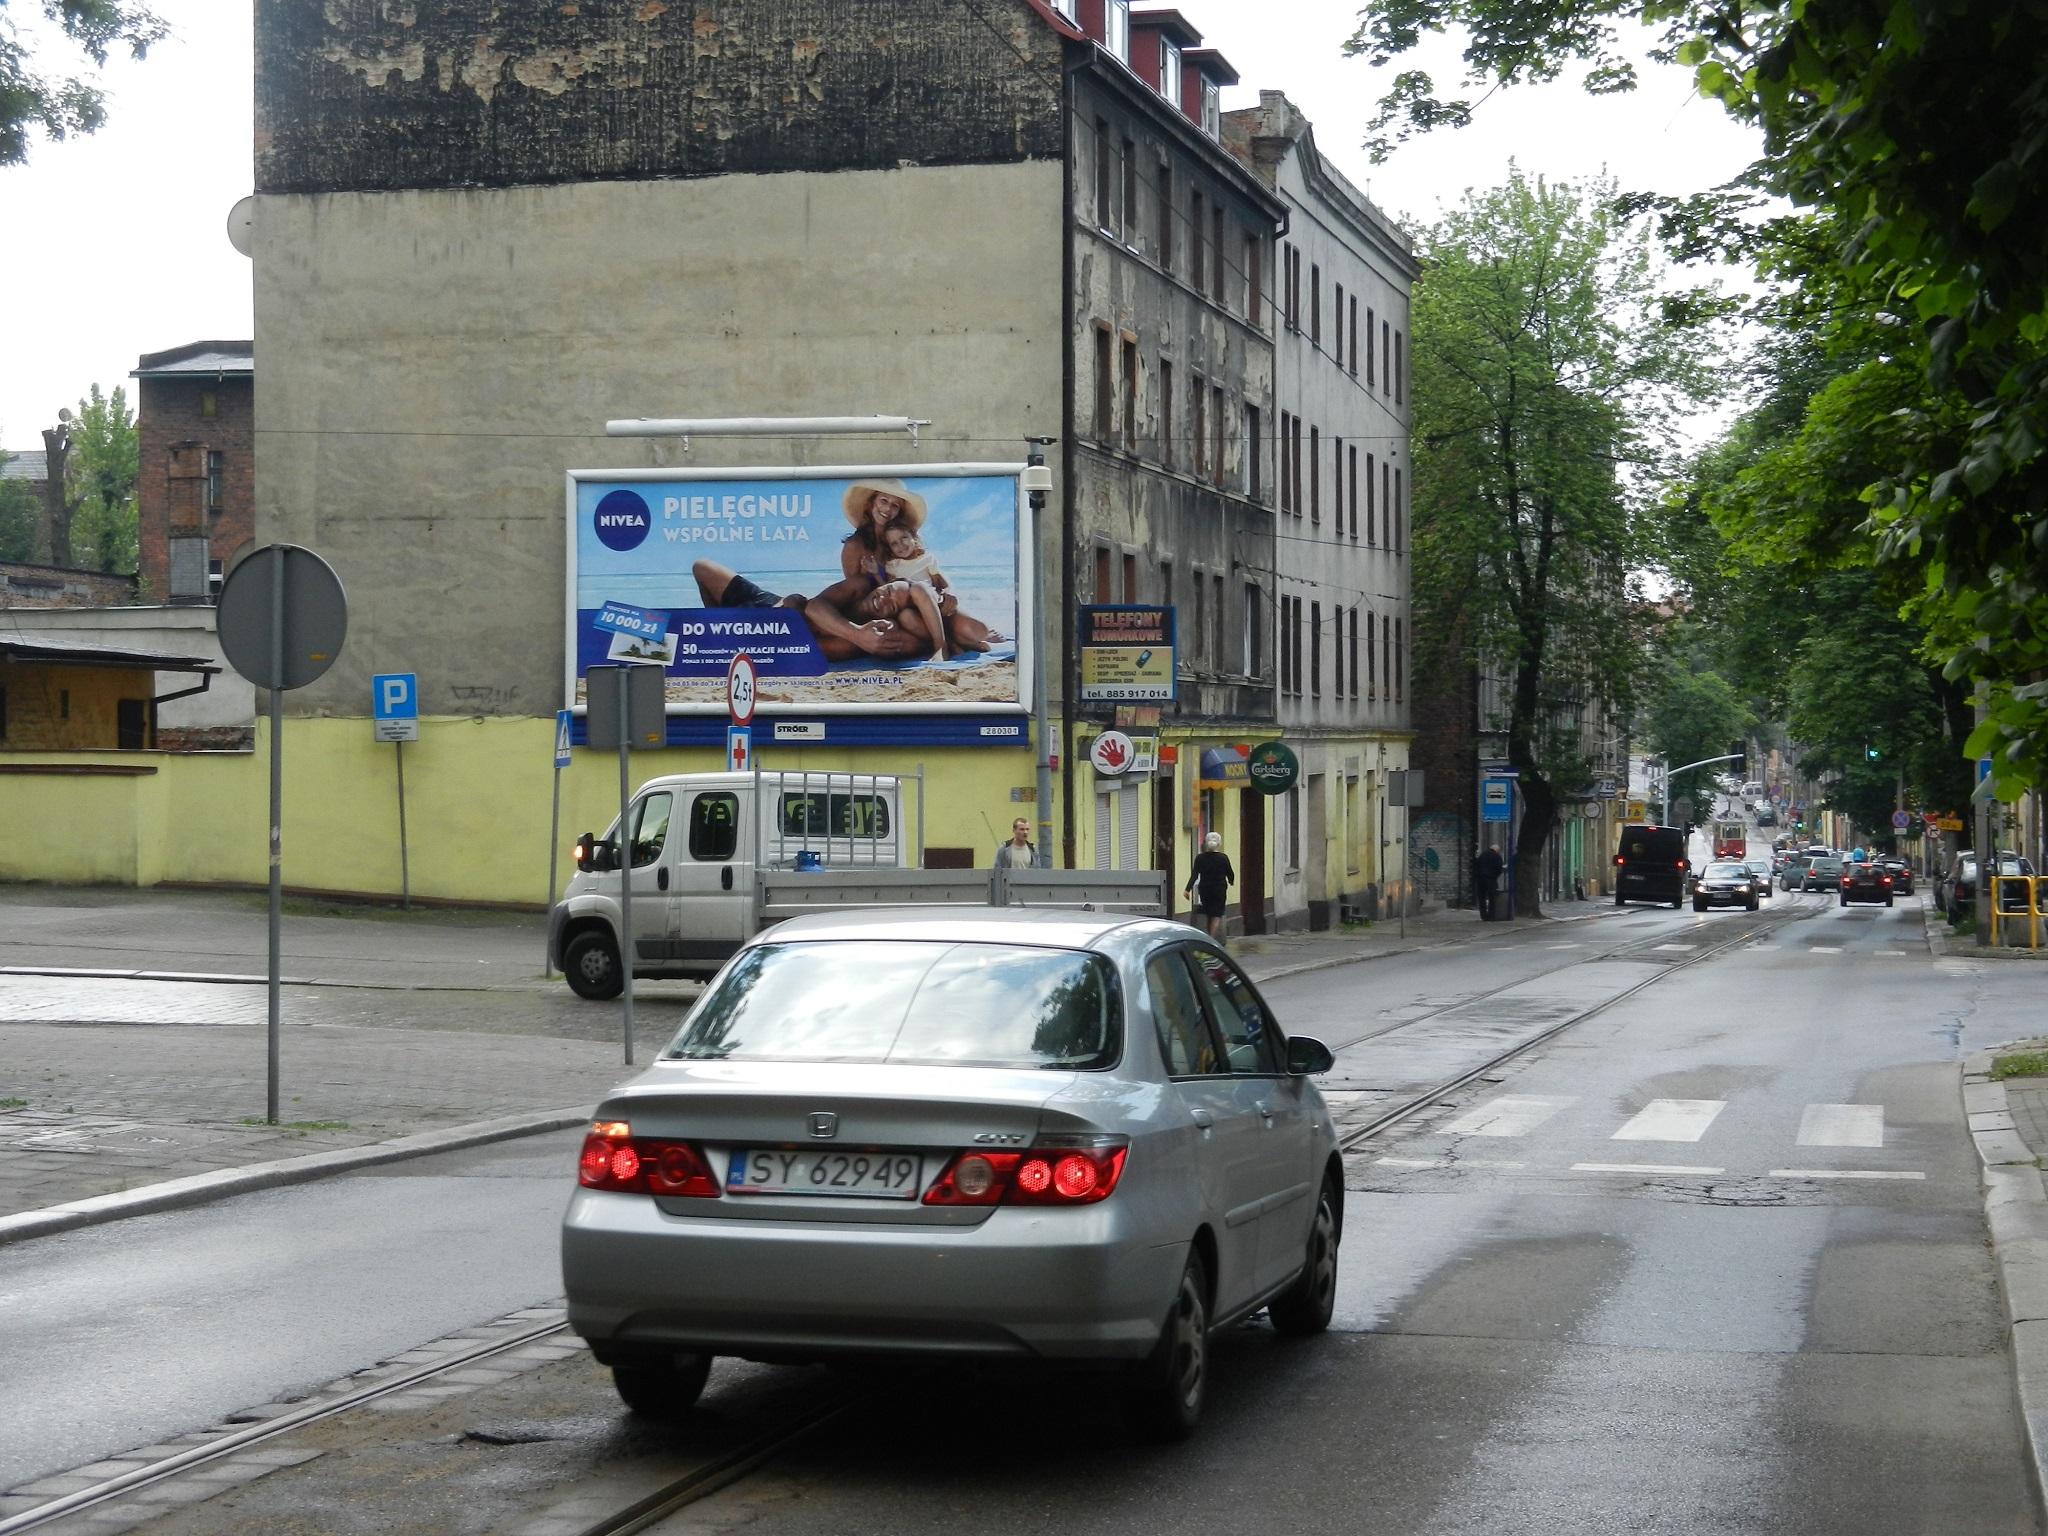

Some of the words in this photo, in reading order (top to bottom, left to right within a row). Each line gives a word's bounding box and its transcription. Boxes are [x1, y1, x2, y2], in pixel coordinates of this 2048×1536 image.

[664, 494, 812, 525] PIELĘGNUJ
[600, 515, 645, 527] NIVEA
[663, 522, 753, 544] WSPÓLNE
[761, 525, 810, 541] LATA
[600, 611, 615, 623] 10
[615, 615, 641, 630] 000
[640, 623, 658, 634] zł
[1092, 612, 1163, 628] TELEFONY
[682, 623, 705, 635] DO
[709, 622, 791, 635] WYGRANIA
[682, 643, 697, 655] 50
[737, 646, 775, 654] WAKACJE
[777, 644, 810, 654] MARZEŃ
[733, 673, 752, 704] 2,5t
[834, 676, 904, 686] WWW.NIVEA.PL
[383, 680, 408, 714] P
[1087, 690, 1103, 698] tel.
[1106, 690, 1125, 698] 885
[1128, 690, 1146, 698] 917
[1149, 690, 1168, 698] 014
[1251, 763, 1291, 776] Carlsberg
[751, 1153, 798, 1184] SY
[809, 1156, 912, 1189] 62949
